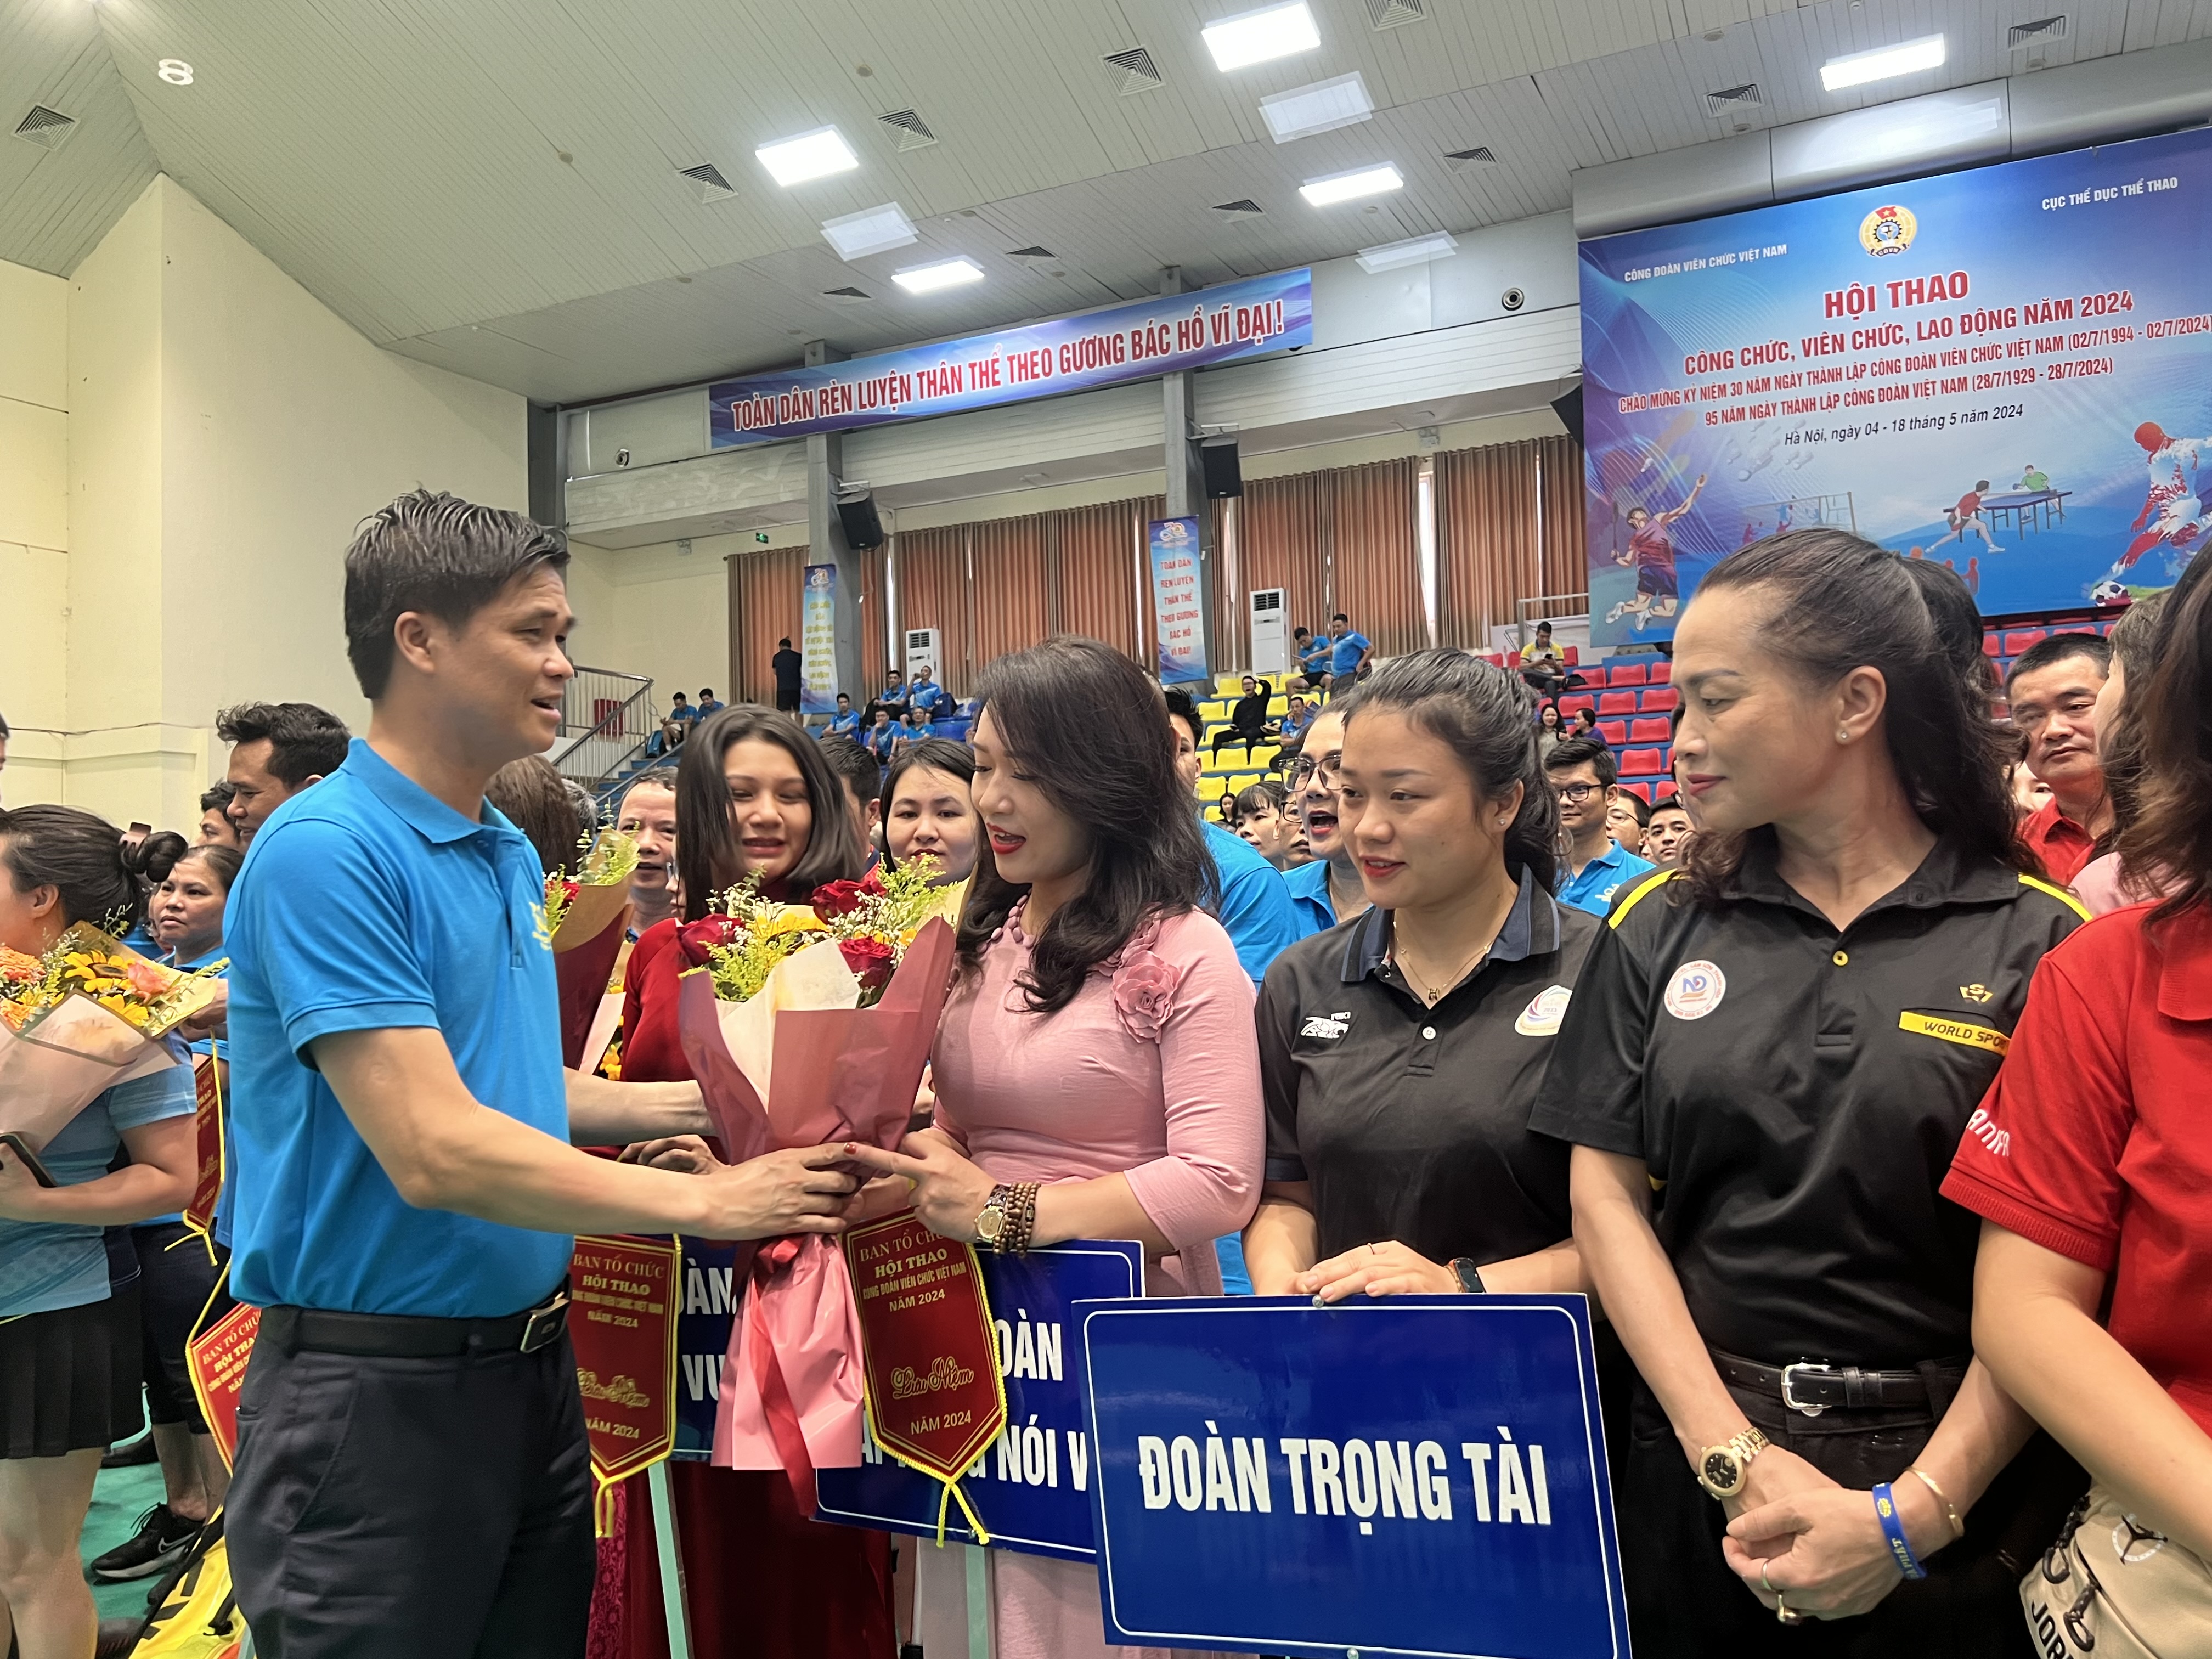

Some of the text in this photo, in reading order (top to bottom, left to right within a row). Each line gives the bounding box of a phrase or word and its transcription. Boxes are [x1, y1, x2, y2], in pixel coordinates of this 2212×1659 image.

[2042, 177, 2178, 212] CỤC THỂ DỤC THỂ THAO
[1624, 244, 1787, 282] CÔNG ĐOÀN VIÊN CHỨC VIỆT NAM
[1825, 270, 1968, 320] HỘI THAO
[1685, 290, 2133, 375] CÔNG CHỨC, VIÊN CHỨC, LAO ĐỘNG NĂM 2024
[732, 397, 775, 431] TOÀN
[780, 388, 814, 424] DÂN
[819, 381, 852, 416] RÈN
[857, 371, 911, 412] LUYỆN
[916, 363, 963, 399] THÂN
[968, 344, 1003, 391] THỂ
[1007, 348, 1052, 384] THEO
[1059, 333, 1125, 374] GƯƠNG
[1131, 319, 1170, 360] BÁC
[1177, 306, 1204, 351] HỒ
[1210, 306, 1232, 345] VĨ
[1618, 393, 1646, 414] CHÀO
[1650, 389, 1680, 409] MỪNG
[1684, 383, 1697, 404] KỶ
[1700, 381, 1727, 403] NIỆM
[1730, 382, 1743, 397] 30
[1746, 376, 1771, 393] NĂM
[1774, 370, 1803, 390] NGÀY
[1806, 365, 1842, 386] THÀNH
[1846, 360, 1866, 383] LẬP
[1871, 357, 1901, 377] CÔNG
[1905, 352, 1937, 371] ĐOÀN
[1940, 347, 1967, 368] VIÊN
[1971, 341, 2002, 363] CHỨC
[2006, 337, 2031, 361] VIỆT
[2035, 335, 2064, 355] NAM
[2068, 326, 2134, 352] (02/7/1994
[1705, 412, 1718, 426] 95
[1721, 406, 1746, 424] NĂM
[1749, 399, 1777, 420] NGÀY
[1781, 394, 1816, 415] THÀNH
[1820, 390, 1840, 412] LẬP
[1844, 387, 1874, 408] CÔNG
[1878, 380, 1910, 404] ĐOÀN
[1912, 377, 1937, 400] VIỆT
[1940, 376, 1968, 394] NAM
[1972, 366, 2036, 392] (28/7/1929
[2047, 357, 2113, 381] 28/7/2024)
[1785, 432, 1800, 445] Hà
[1804, 427, 1827, 445] Nội,
[1831, 425, 1861, 443] ngày
[1865, 422, 1879, 435] 04
[1892, 419, 1905, 431] 18
[1909, 415, 1945, 430] tháng
[1949, 412, 1957, 425] 5
[1961, 407, 1988, 422] năm
[1993, 403, 2023, 420] 2024
[1925, 1022, 1973, 1039] WORLD
[573, 1253, 665, 1279] BAN TỔ CHỨC
[860, 1242, 890, 1262] BAN
[893, 1229, 912, 1252] TỔ
[874, 1248, 947, 1278] HỘI THAO
[583, 1274, 651, 1295] HỘI THAO
[679, 1258, 733, 1314] ÀN
[900, 1274, 916, 1290] VIÊN
[917, 1268, 935, 1285] CHỨC
[936, 1265, 950, 1282] VIỆT
[951, 1261, 967, 1276] NAM
[889, 1288, 945, 1313] NĂM 2024
[202, 1343, 223, 1364] BAN
[214, 1352, 233, 1373] HỘI
[233, 1331, 259, 1357] THA
[994, 1308, 1063, 1381] OÀN
[891, 1356, 974, 1400] Lưu Niệm
[612, 1424, 639, 1440] 2024
[911, 1410, 972, 1435] NĂM 2024
[997, 1414, 1088, 1491] NÓI V
[1138, 1420, 1551, 1536] ĐOÀN TRỌNG TÀI
[2032, 1600, 2074, 1659] JOR
